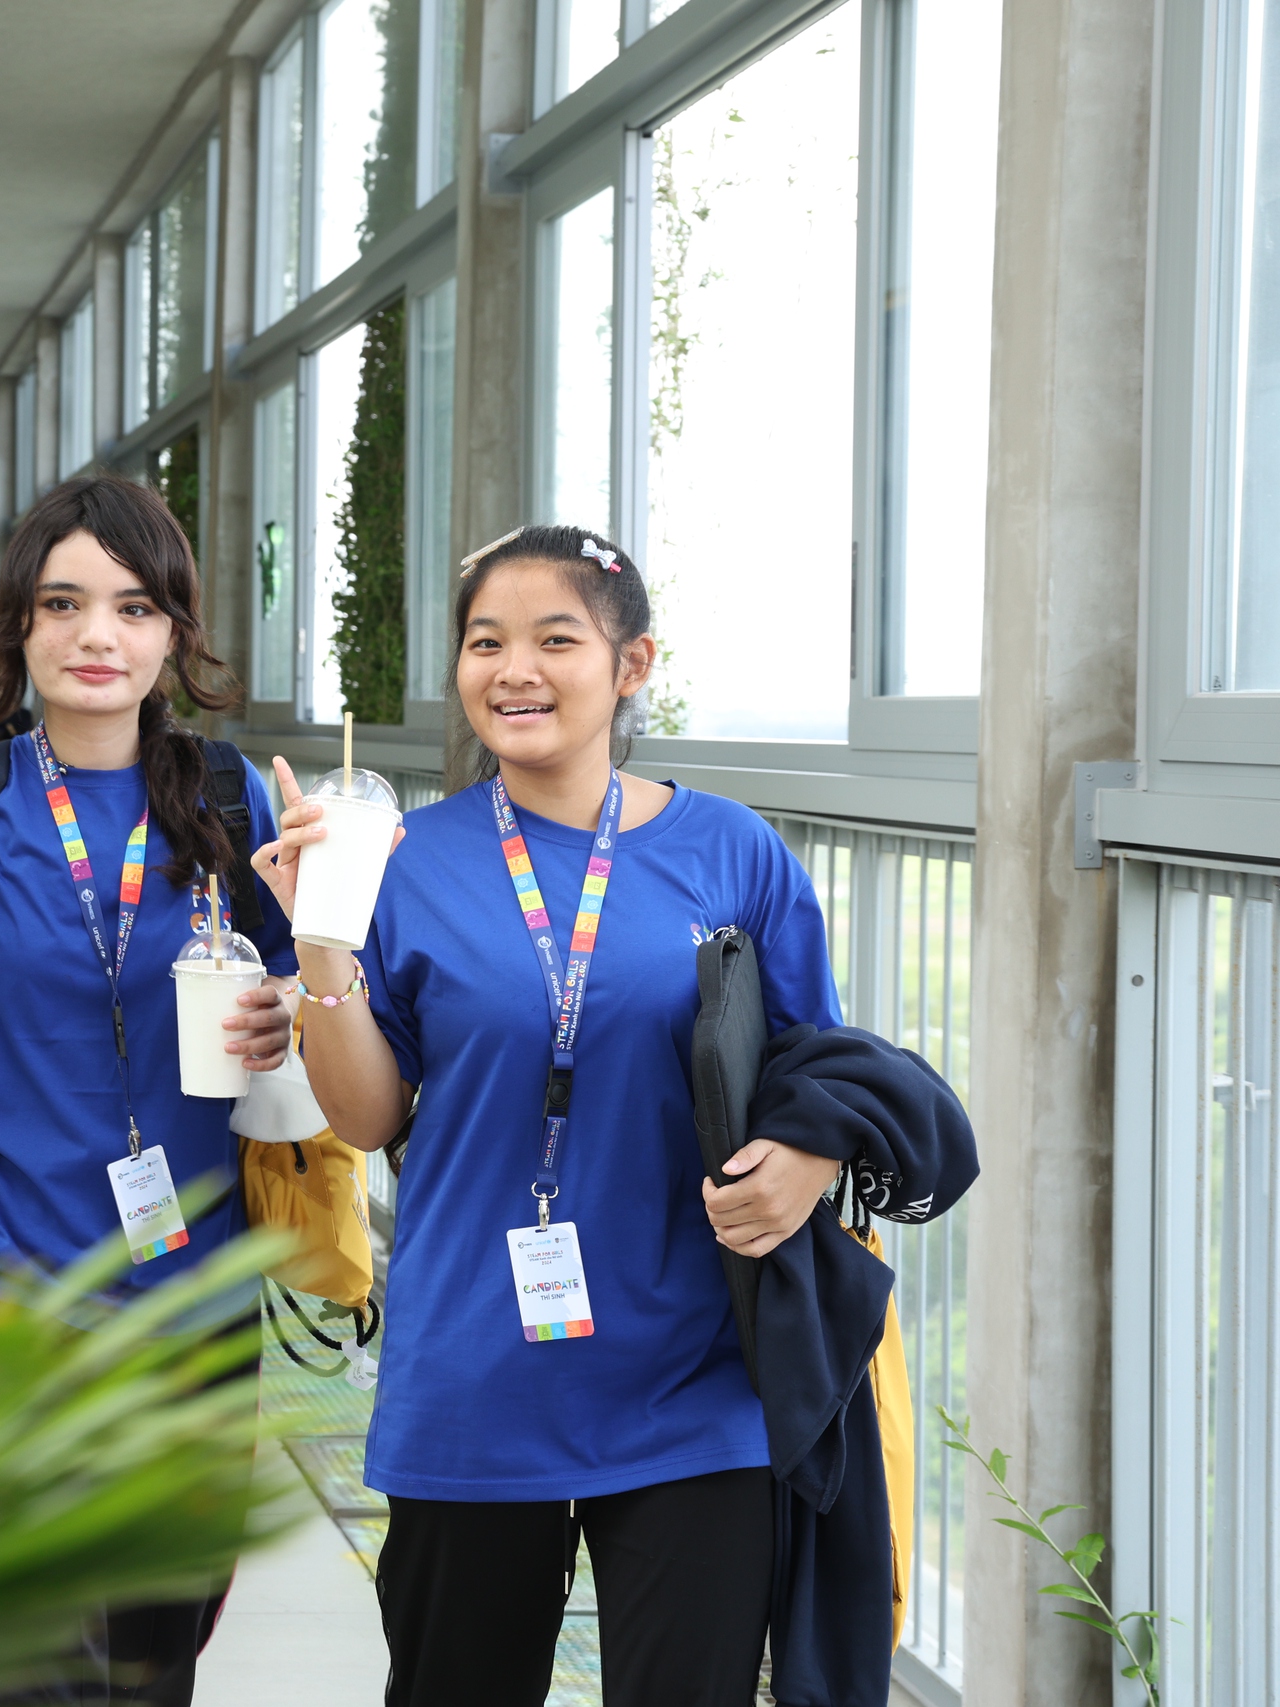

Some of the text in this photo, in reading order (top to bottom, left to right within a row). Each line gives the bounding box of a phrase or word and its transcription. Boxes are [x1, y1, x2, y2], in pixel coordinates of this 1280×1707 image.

[608, 794, 618, 816] unicef
[502, 806, 516, 830] GIRLS
[92, 926, 104, 950] unicef
[550, 972, 562, 996] unicef
[557, 960, 579, 1049] STEAM FOR GIRLS
[566, 1030, 576, 1050] STEAM
[578, 960, 587, 978] 2024
[127, 1196, 172, 1220] CANDIDATE
[524, 1279, 579, 1294] CANDIDATE
